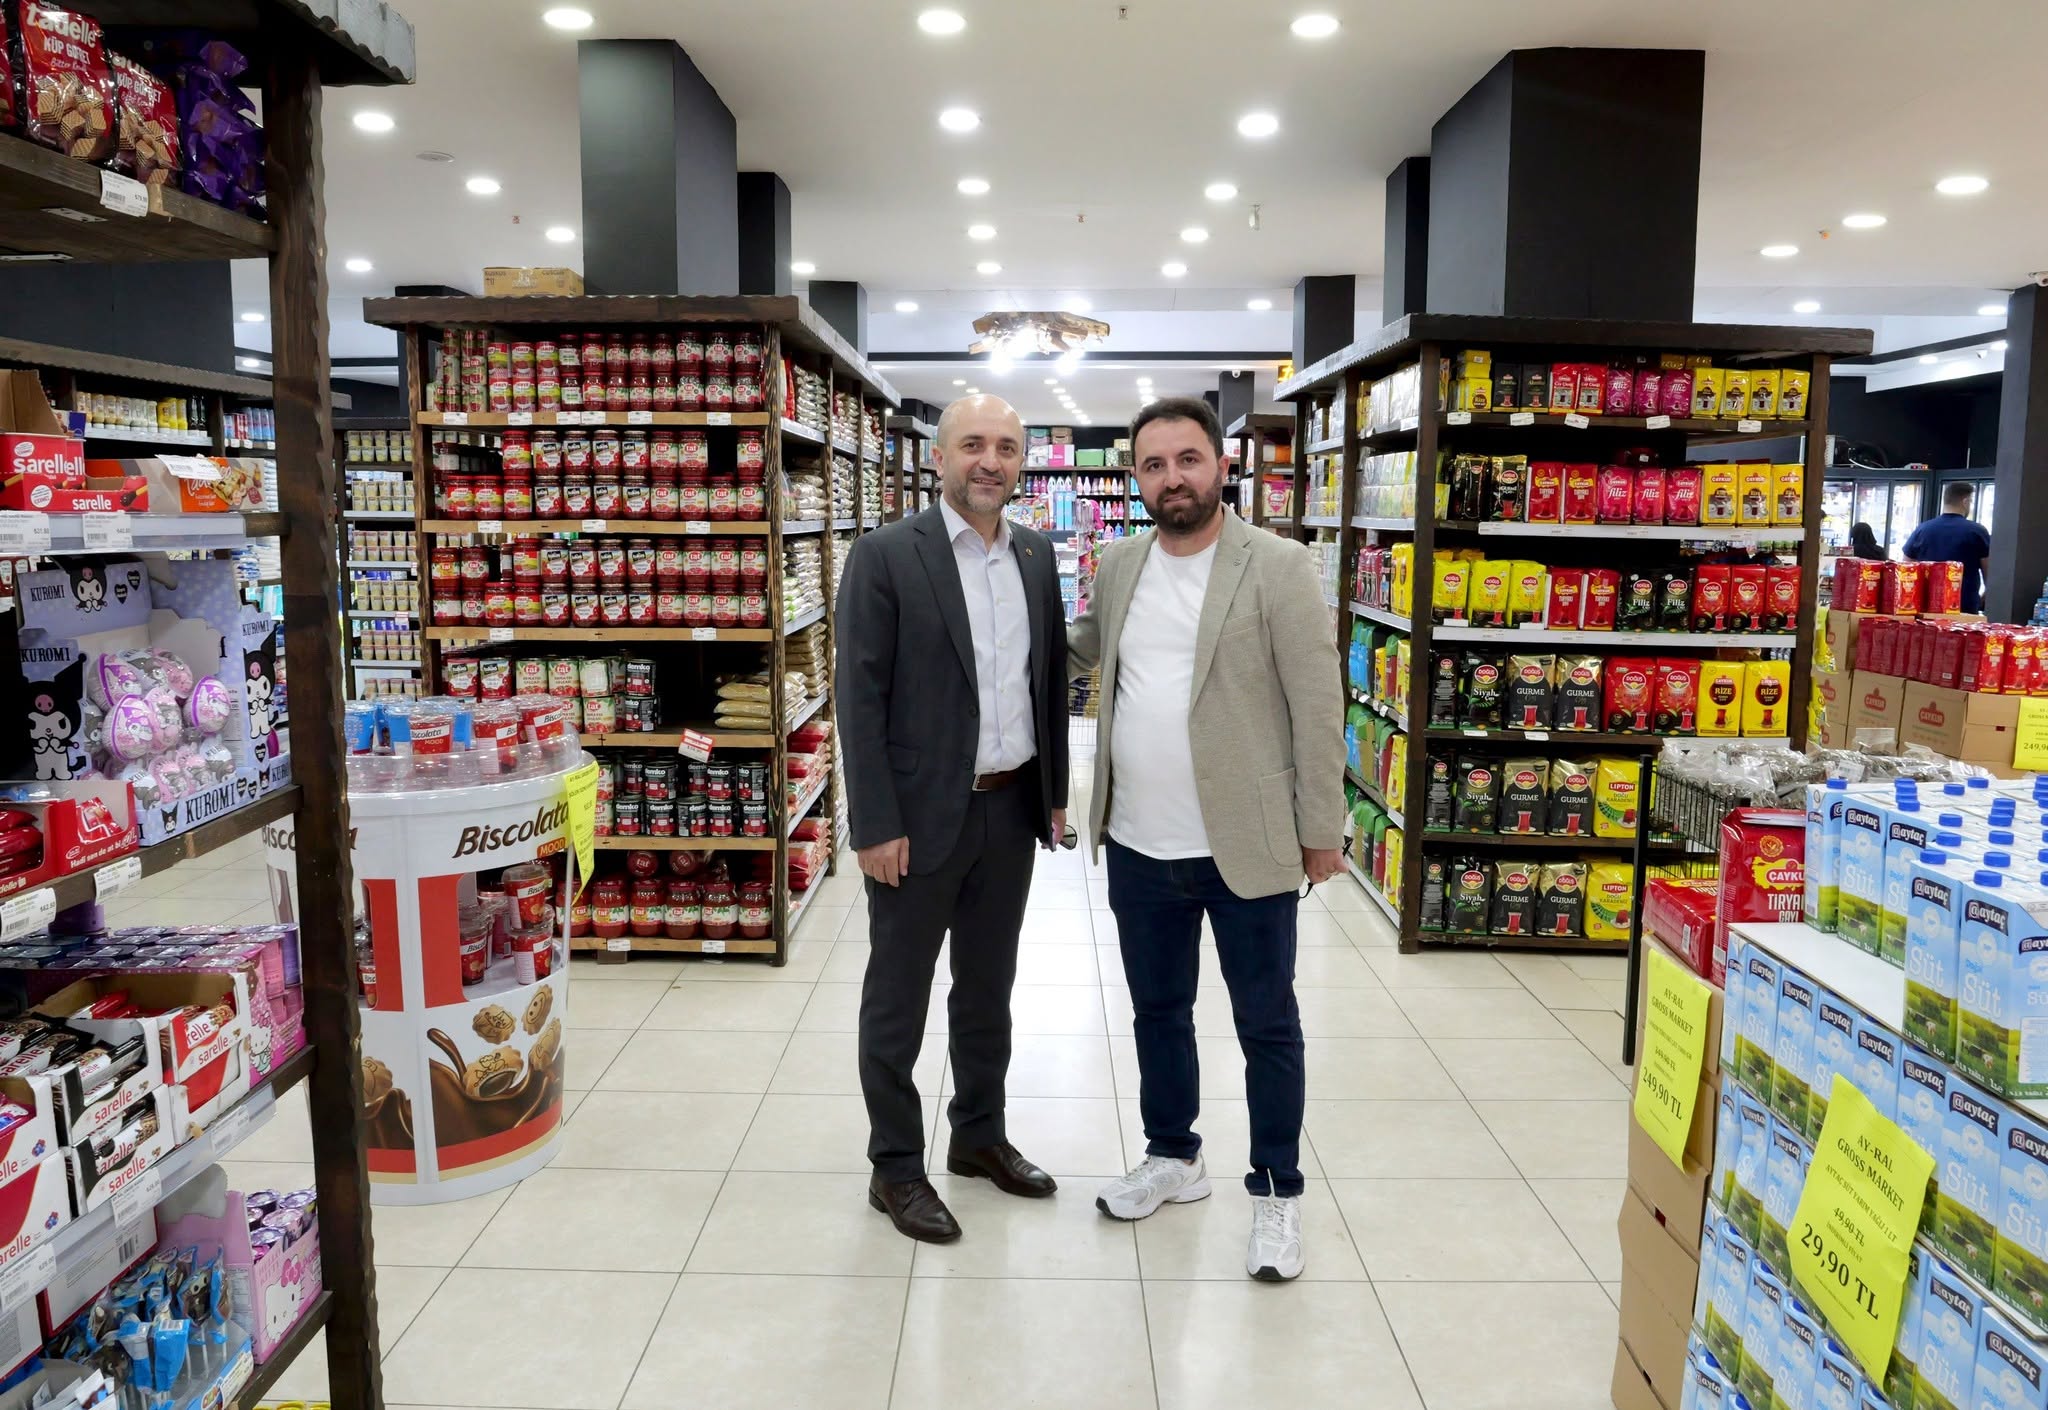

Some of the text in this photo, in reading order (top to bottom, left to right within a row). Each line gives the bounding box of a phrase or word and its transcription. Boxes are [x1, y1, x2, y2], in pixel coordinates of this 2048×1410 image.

[27, 3, 96, 48] tadelle
[72, 494, 112, 510] sarelle
[1609, 488, 1627, 498] filiz
[1642, 489, 1660, 499] filiz
[1676, 490, 1694, 499] filiz
[30, 584, 65, 602] KUROMI
[242, 620, 270, 635] KUROMI
[21, 647, 71, 663] KUROMI
[525, 665, 539, 674] tat
[556, 665, 569, 674] tat
[1473, 687, 1498, 698] Siyah
[1516, 687, 1545, 696] GURME
[1566, 689, 1595, 697] GURME
[1714, 687, 1733, 695] RİZE
[1760, 687, 1779, 696] RİZE
[587, 702, 600, 711] tat
[185, 783, 236, 825] KUROMI
[650, 803, 673, 811] demko
[709, 803, 731, 811] demko
[1466, 792, 1493, 802] Siyah
[452, 800, 569, 858] Biscolata
[539, 837, 565, 857] MOOD
[1844, 862, 1875, 896] Süt
[1460, 893, 1486, 903] Siyah
[1501, 895, 1529, 903] GURME
[1550, 896, 1578, 904] GURME
[1888, 881, 1908, 911] Sü
[1909, 947, 1944, 988] Süt
[1664, 987, 1684, 1010] AY-RAL
[1963, 973, 2001, 1018] Süt
[2027, 991, 2048, 1006] Sü
[1651, 995, 1693, 1036] GROSS MARKET
[187, 1022, 211, 1045] relle
[198, 1036, 229, 1066] sarelle
[1642, 1066, 1669, 1106] 249,90
[1670, 1095, 1682, 1120] TL
[95, 1089, 133, 1124] sarelle
[1857, 1135, 1893, 1174] AY-RAL
[109, 1156, 146, 1193] sarelle
[1837, 1138, 1904, 1212] GROSS MARKET
[1945, 1161, 1989, 1213] Süt
[1853, 1191, 1870, 1214] YARIM
[1833, 1207, 1865, 1247] 49,90 TL
[2006, 1202, 2048, 1262] Sü
[1800, 1222, 1849, 1287] 29,90
[1855, 1276, 1879, 1320] TL
[1922, 1343, 1960, 1400] Süt
